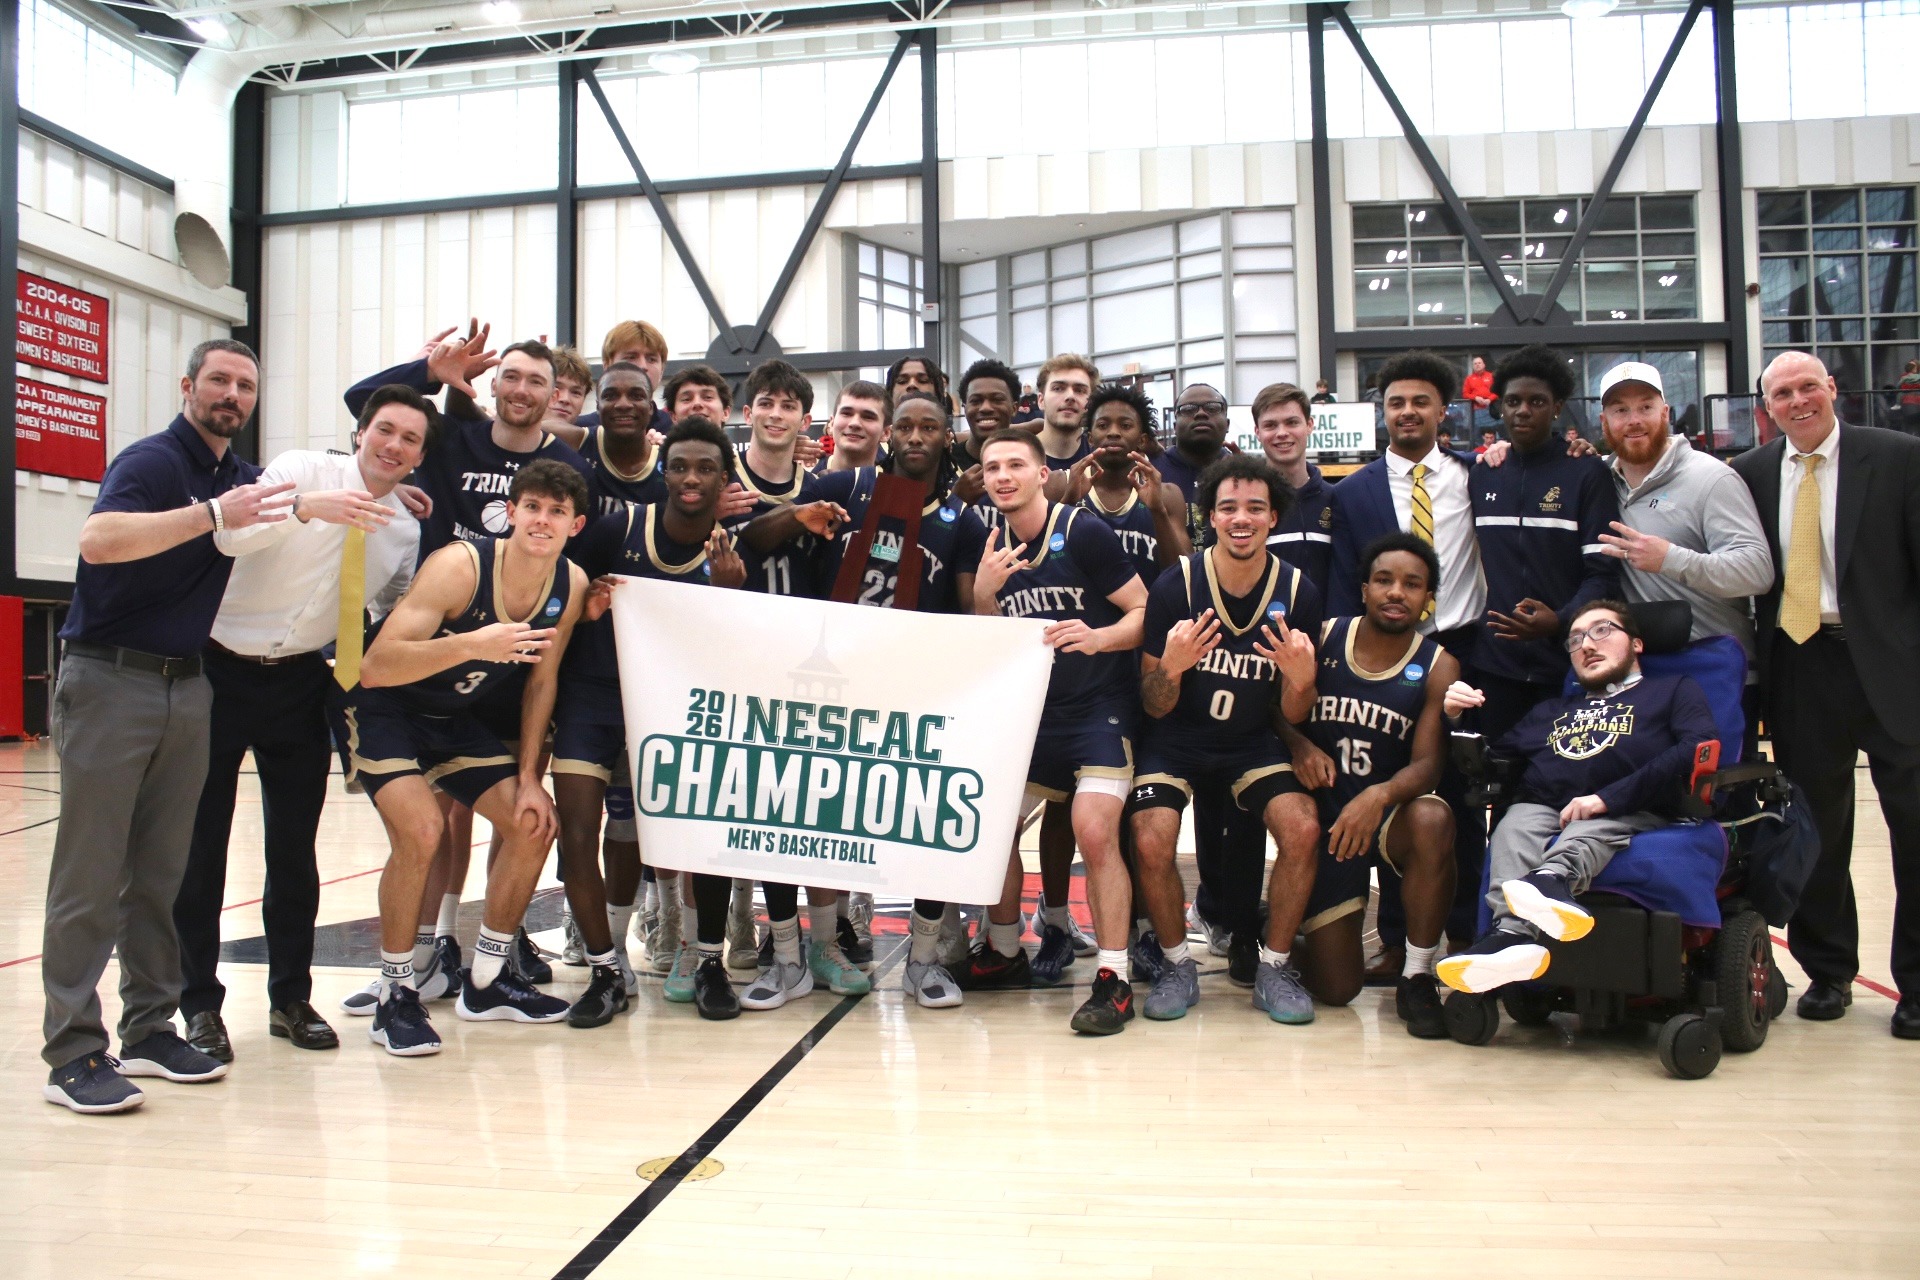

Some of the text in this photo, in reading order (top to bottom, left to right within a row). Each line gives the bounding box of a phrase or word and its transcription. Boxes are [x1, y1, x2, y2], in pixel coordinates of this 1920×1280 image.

[26, 282, 92, 315] 2004-05
[19, 320, 99, 355] SWEET SIXTEEN
[54, 310, 88, 333] DIVISION
[89, 321, 101, 337] III
[51, 349, 102, 376] BASKETBALL
[16, 398, 98, 426] APPEARANCES
[40, 388, 102, 412] TOURNAMENT
[49, 420, 101, 441] BASKETBALL
[761, 555, 791, 595] 11
[454, 670, 489, 695] 3
[1209, 689, 1235, 721] 0
[743, 695, 946, 763] NESCAC
[1336, 736, 1372, 777] 15
[638, 738, 979, 849] CHAMPIONS
[778, 833, 877, 865] BASKETBALL
